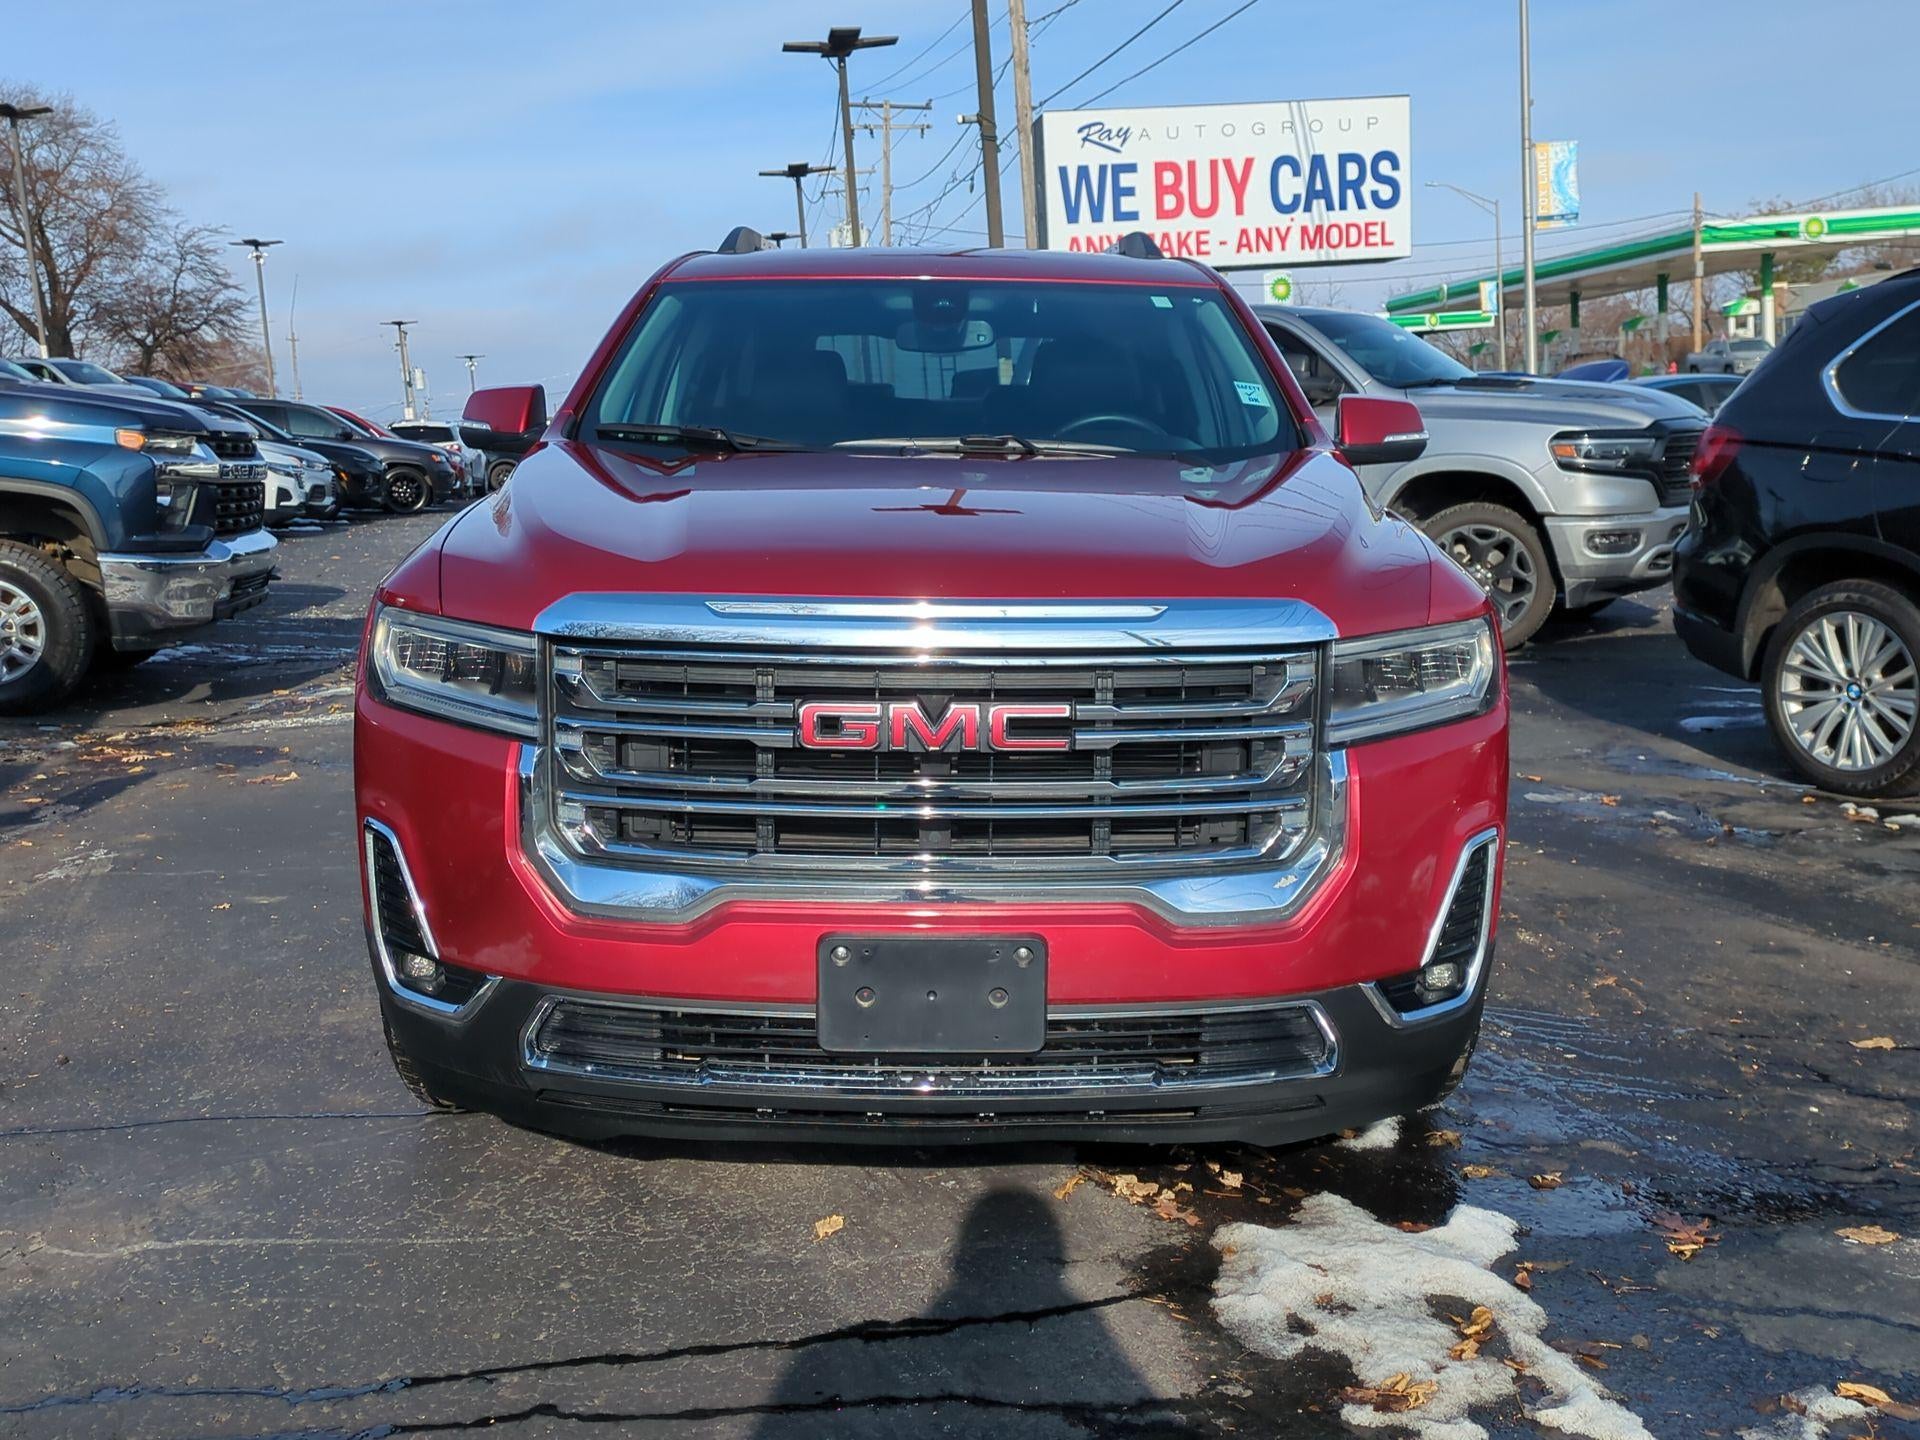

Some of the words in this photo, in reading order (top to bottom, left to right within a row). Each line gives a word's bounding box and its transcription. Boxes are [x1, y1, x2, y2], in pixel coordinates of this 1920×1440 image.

[1077, 121, 1132, 153] Ray
[1058, 162, 1140, 224] WE
[1153, 156, 1255, 220] BUY
[1269, 150, 1402, 215] CARS
[1148, 229, 1211, 258] AKE
[1236, 225, 1293, 254] ANY
[1300, 220, 1395, 250] MODEL
[799, 702, 1073, 751] GMC
